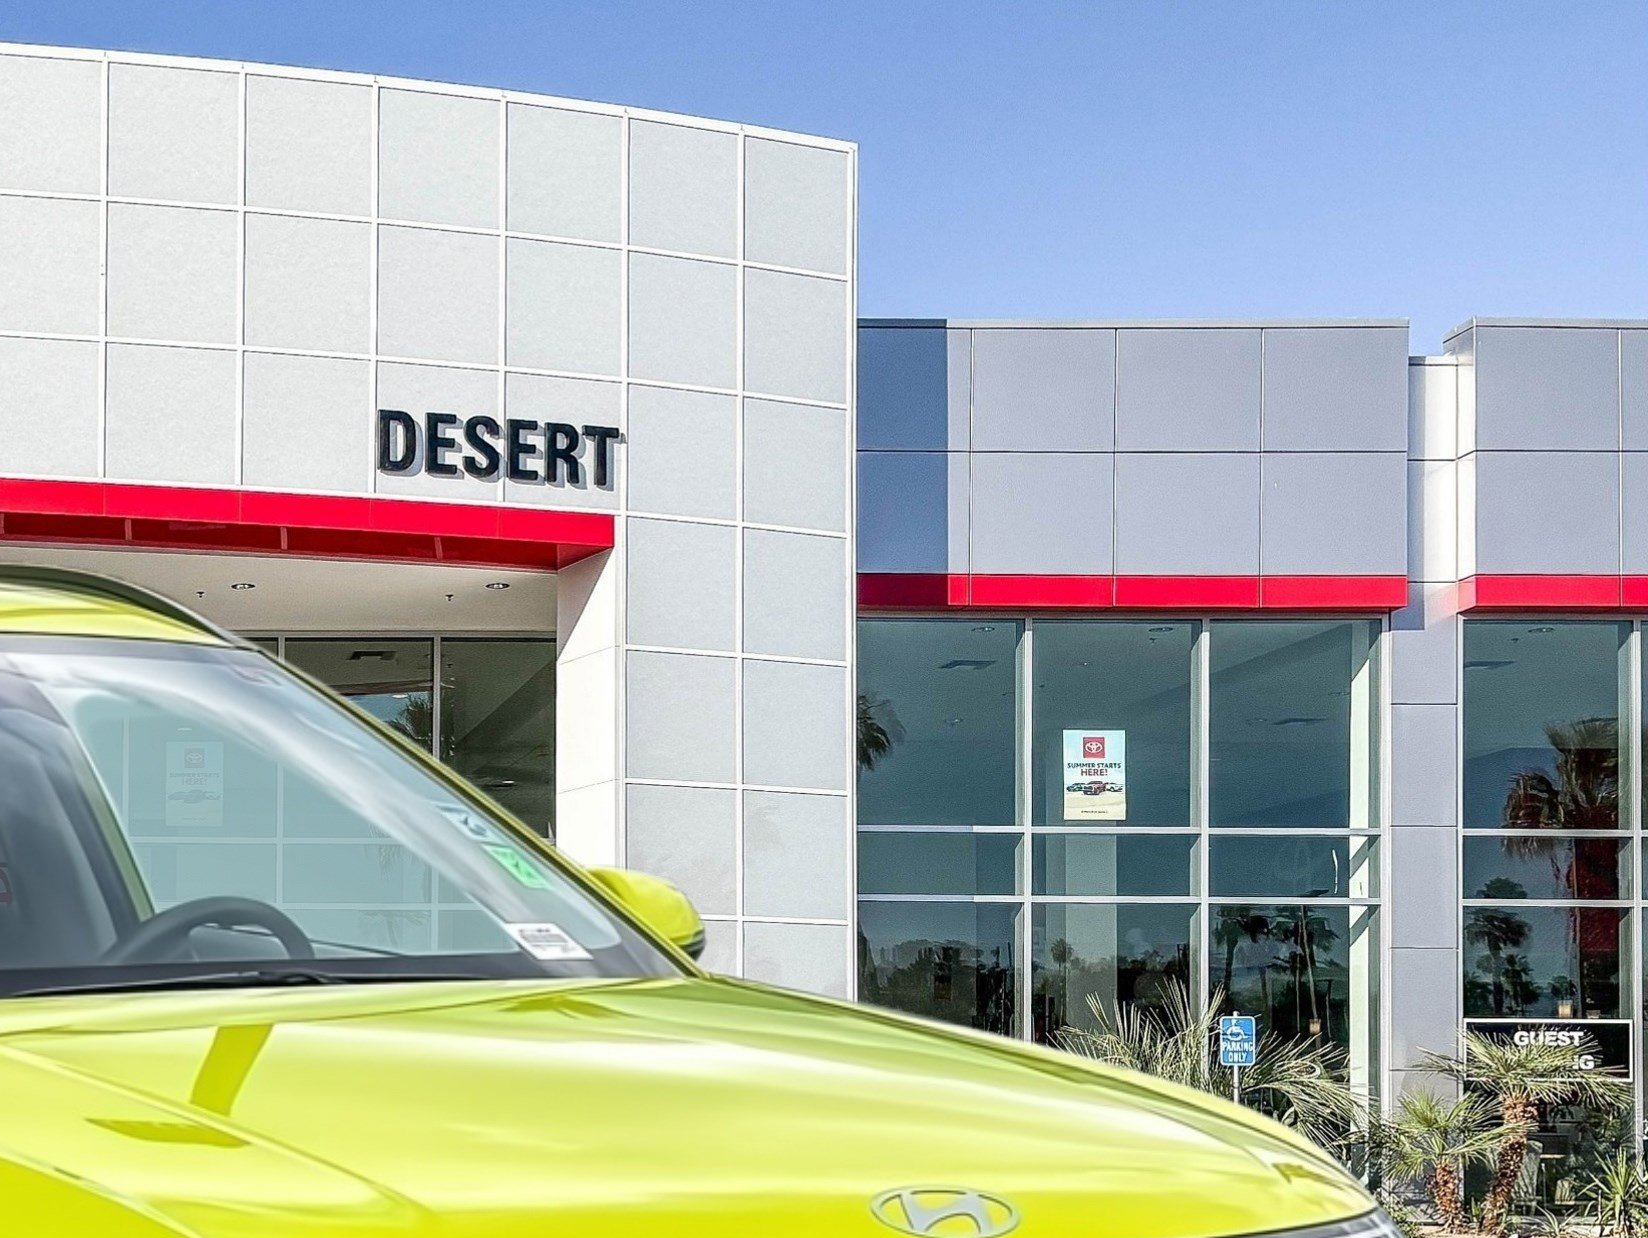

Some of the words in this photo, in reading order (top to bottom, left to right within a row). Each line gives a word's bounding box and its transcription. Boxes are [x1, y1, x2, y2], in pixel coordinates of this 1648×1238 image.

[377, 409, 620, 487] DESERT
[1513, 1031, 1584, 1046] GUEST
[1222, 1041, 1253, 1051] PARKING
[1228, 1052, 1247, 1062] ONLY
